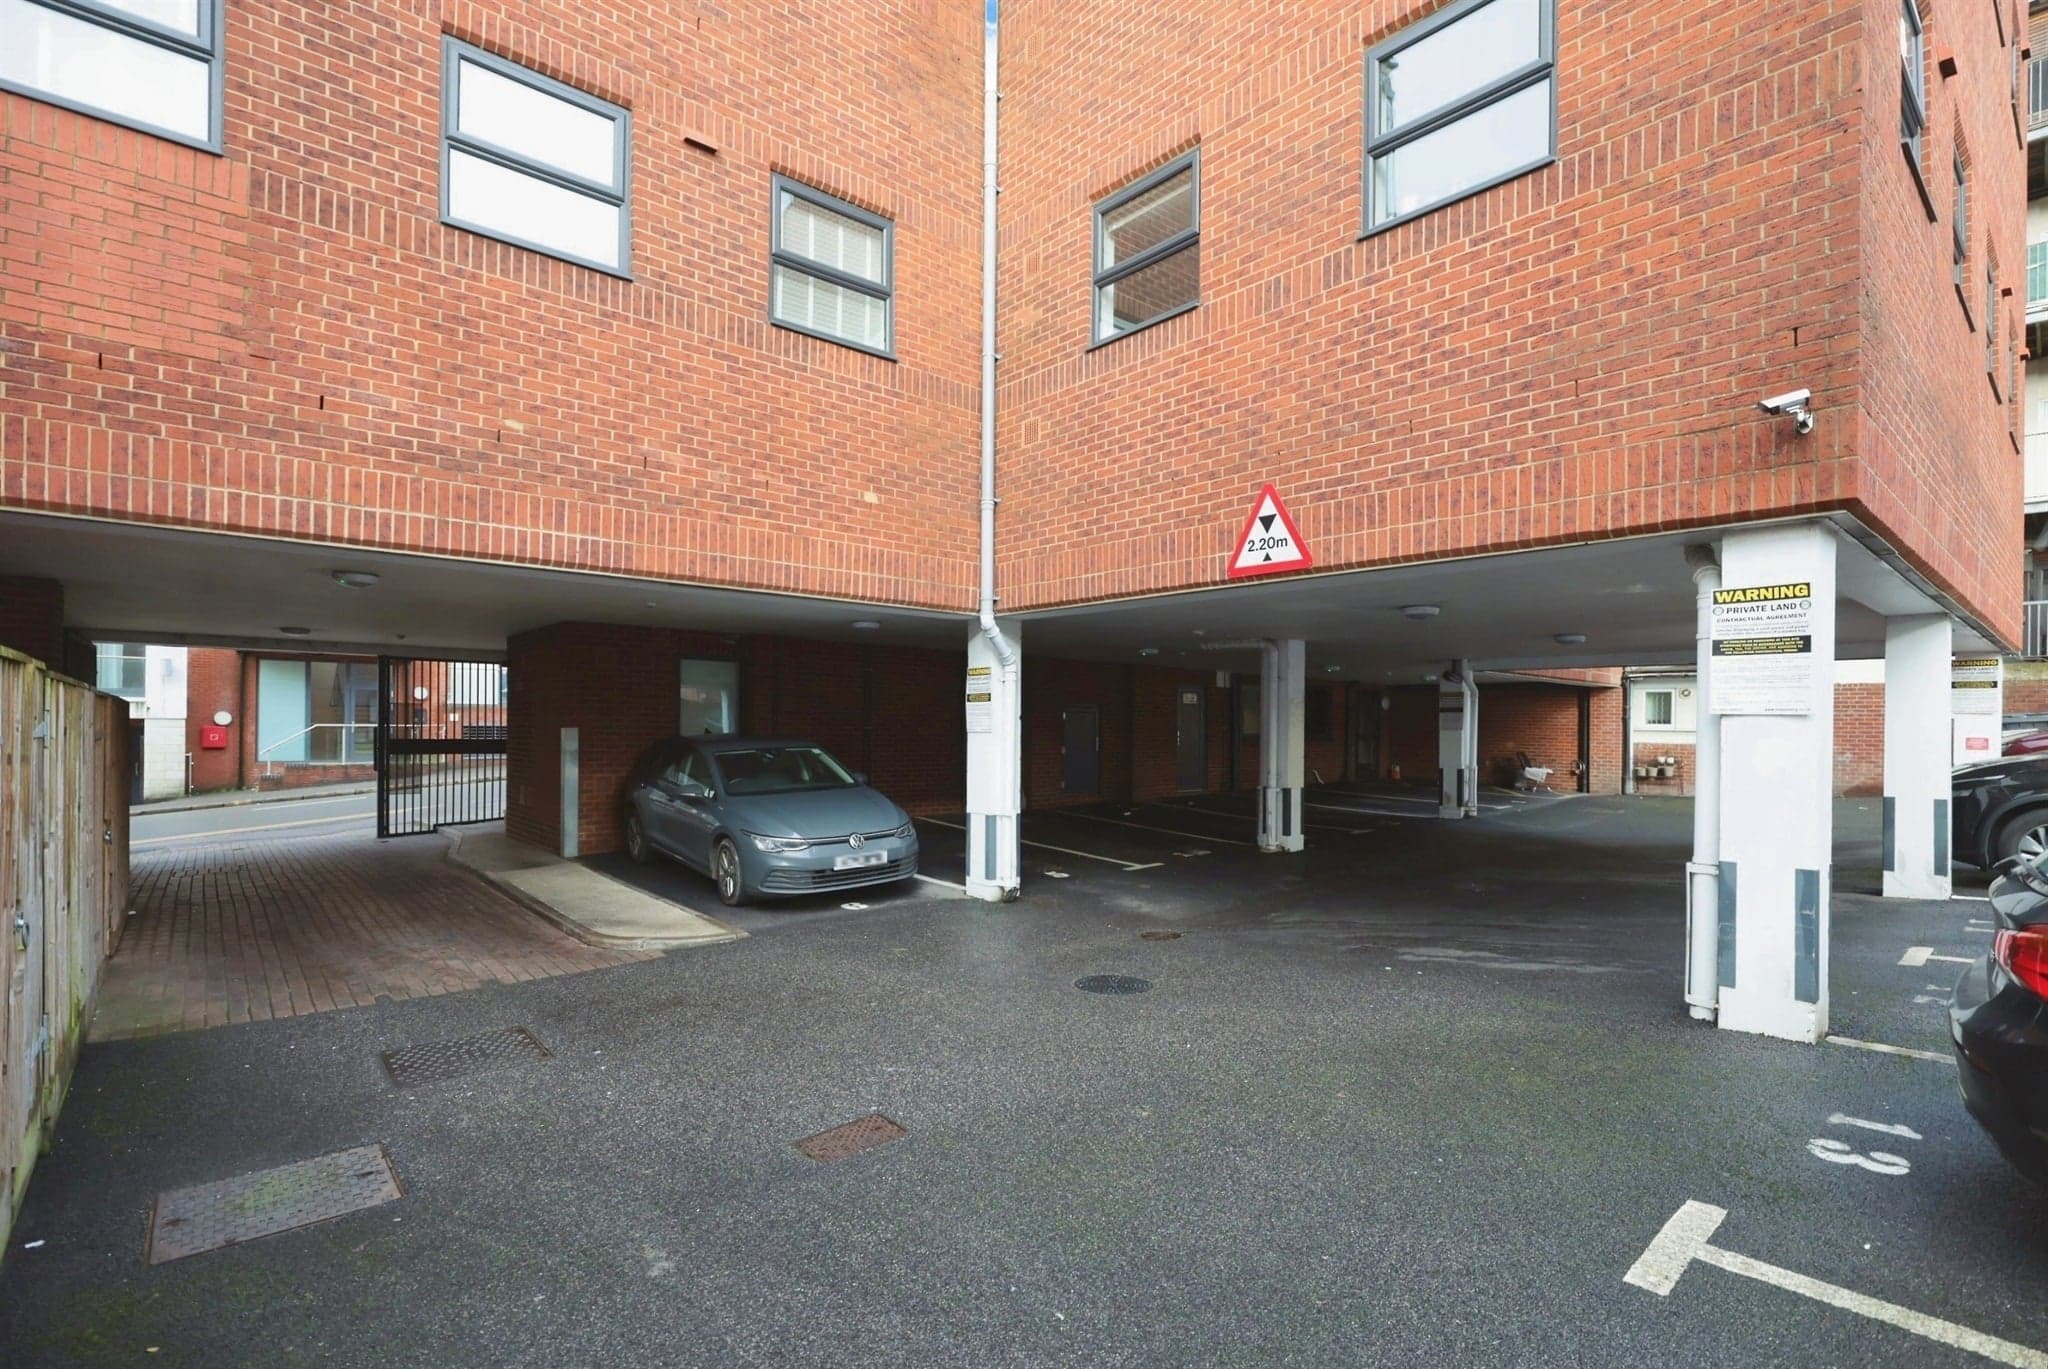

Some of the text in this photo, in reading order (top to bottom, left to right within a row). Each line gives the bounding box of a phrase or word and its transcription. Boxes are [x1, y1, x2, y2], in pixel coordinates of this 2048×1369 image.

[1247, 536, 1288, 552] 2.20m
[1715, 584, 1809, 603] WARNING
[1726, 602, 1797, 614] PRIVATE LAND
[1766, 612, 1807, 620] AGREEMENT
